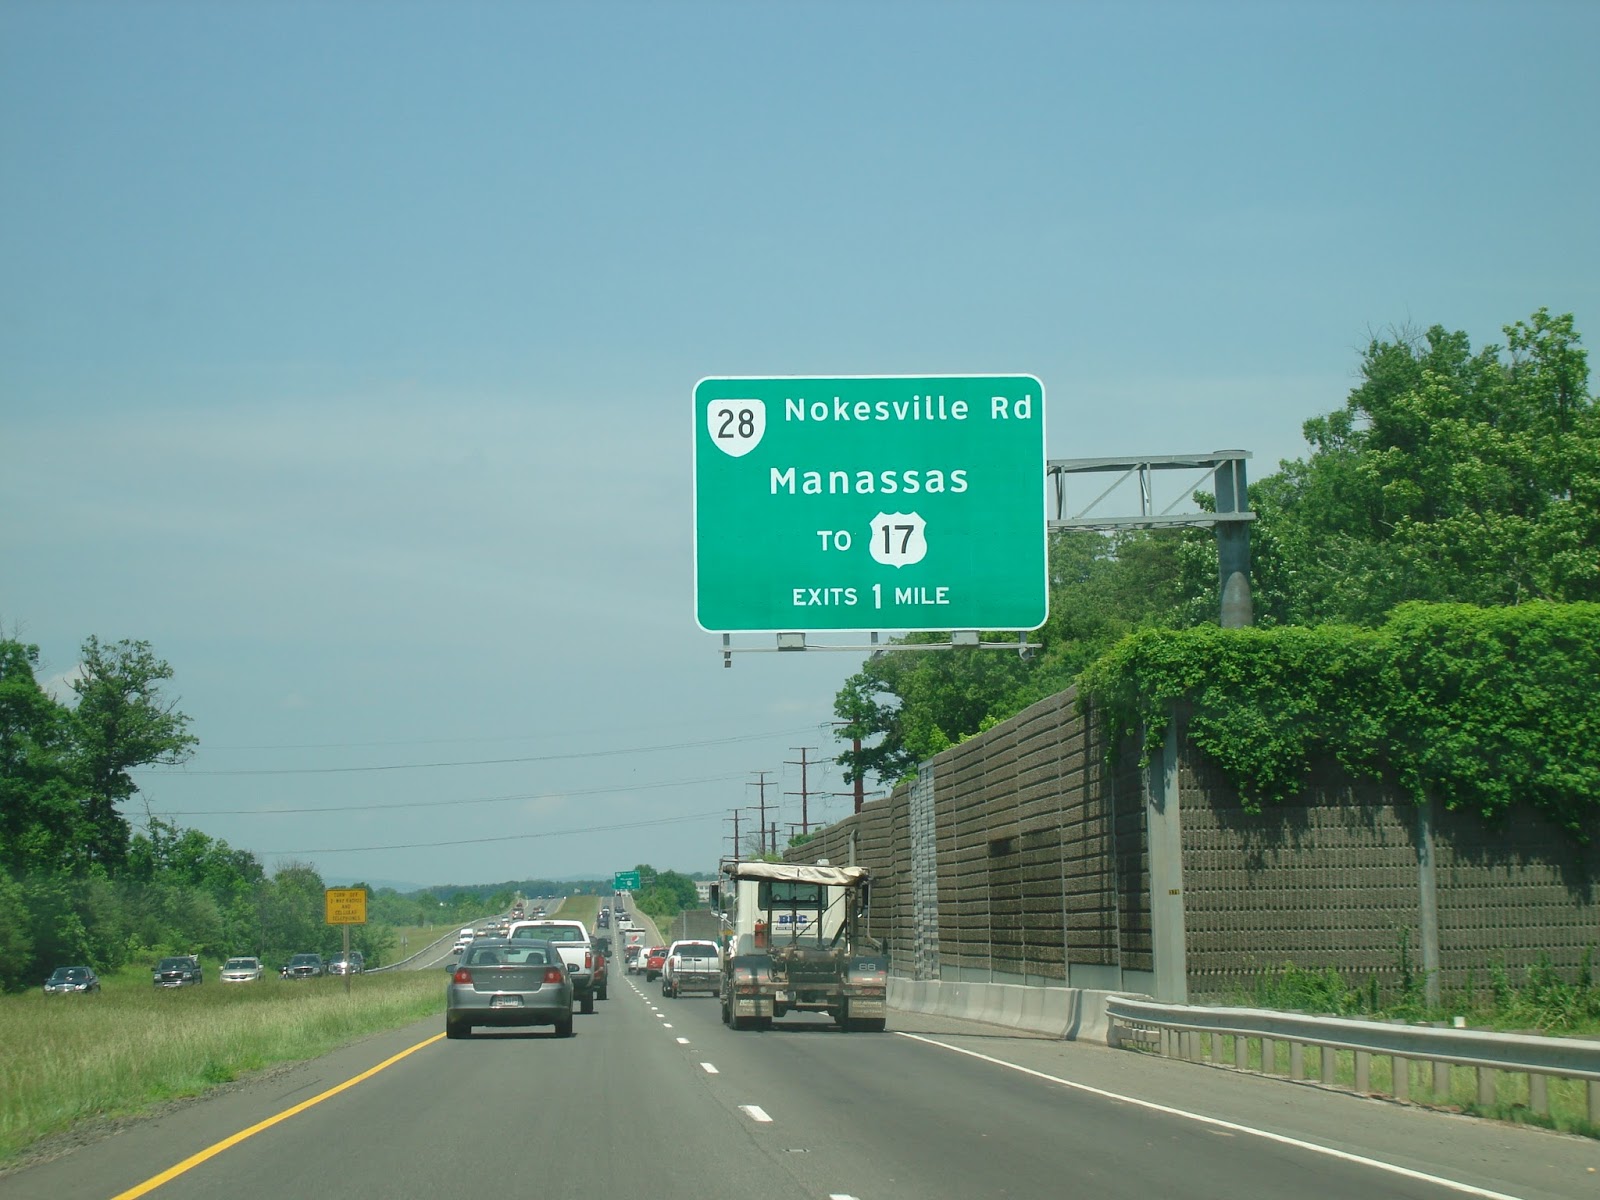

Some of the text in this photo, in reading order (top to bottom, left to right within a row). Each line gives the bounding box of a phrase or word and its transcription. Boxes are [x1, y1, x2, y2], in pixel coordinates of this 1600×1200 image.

[785, 394, 1031, 422] Nokesville Rd
[717, 408, 755, 439] 28
[770, 467, 968, 495] Manassas
[816, 524, 915, 555] TO 17
[792, 583, 950, 609] EXITS 1 MILE
